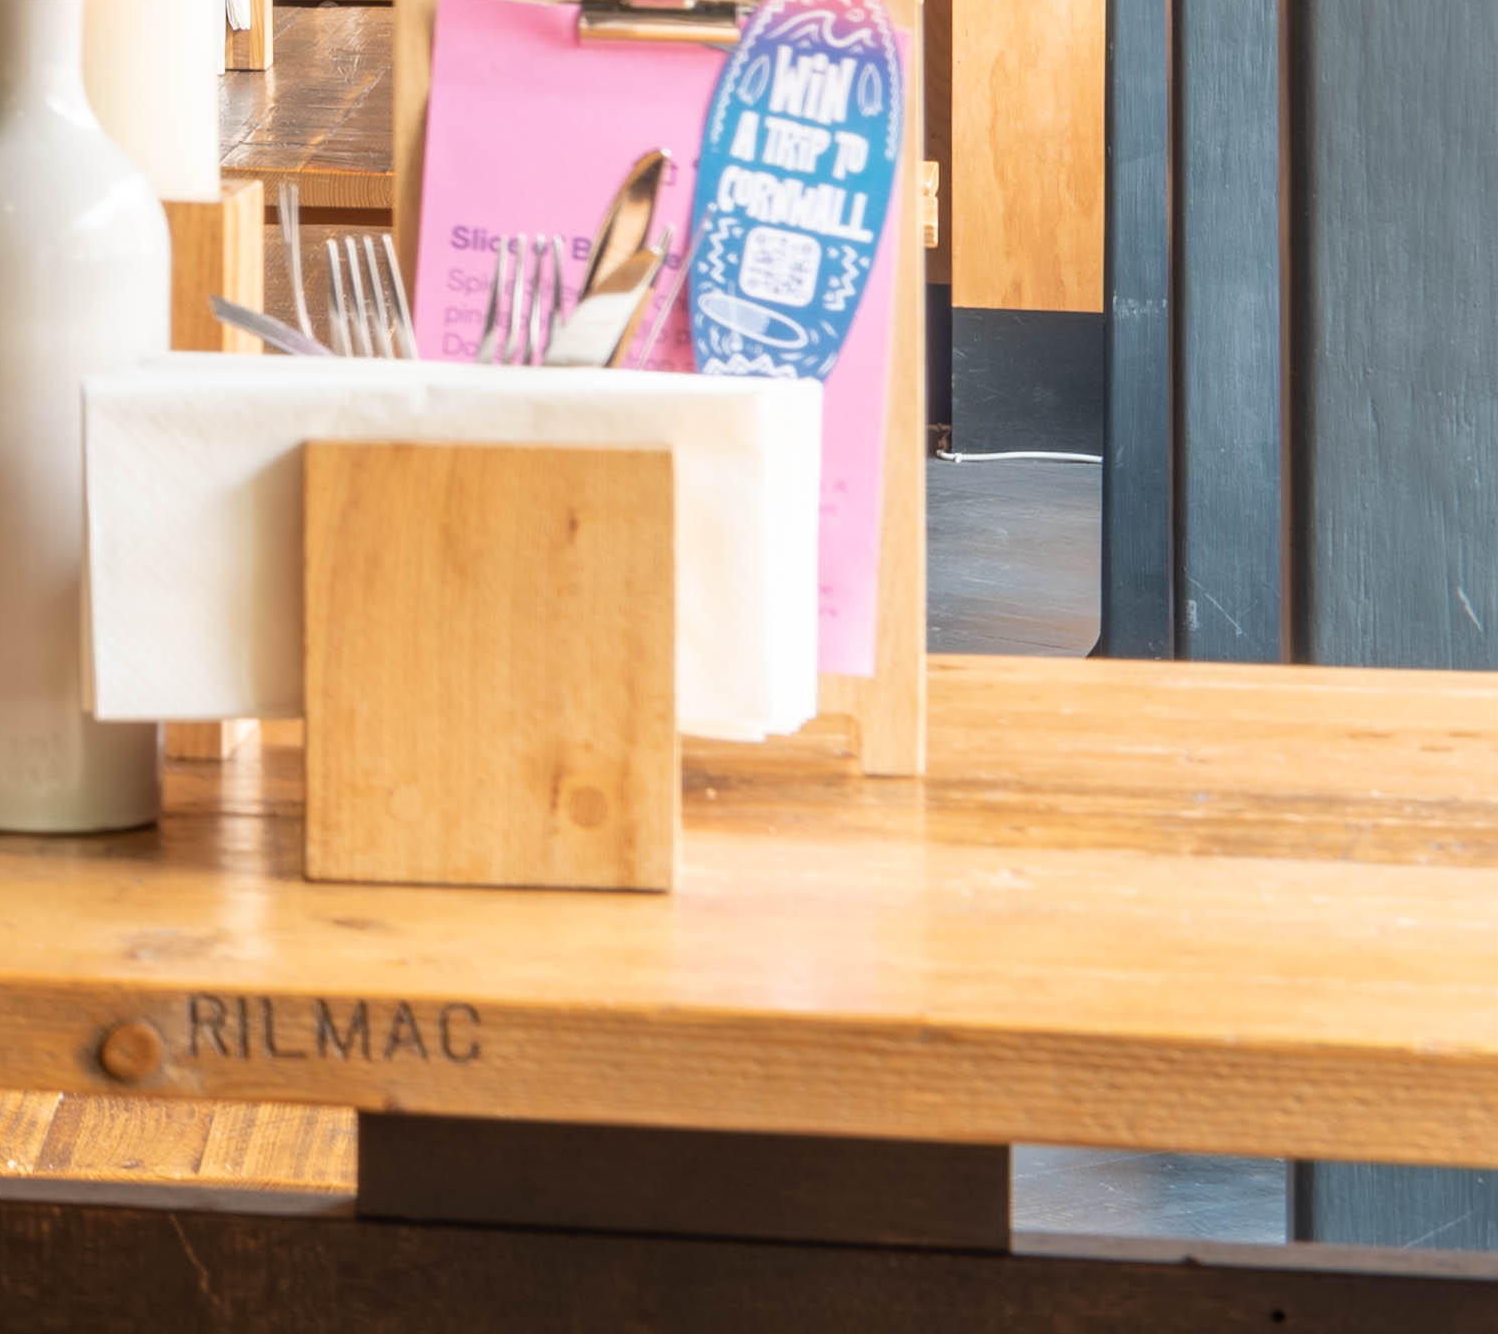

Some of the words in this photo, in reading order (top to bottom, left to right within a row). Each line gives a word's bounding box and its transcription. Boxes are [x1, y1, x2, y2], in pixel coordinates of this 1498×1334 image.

[729, 110, 760, 162] A
[831, 130, 870, 181] TO
[717, 164, 874, 244] CORNWALL
[187, 991, 483, 1064] RILMAC
